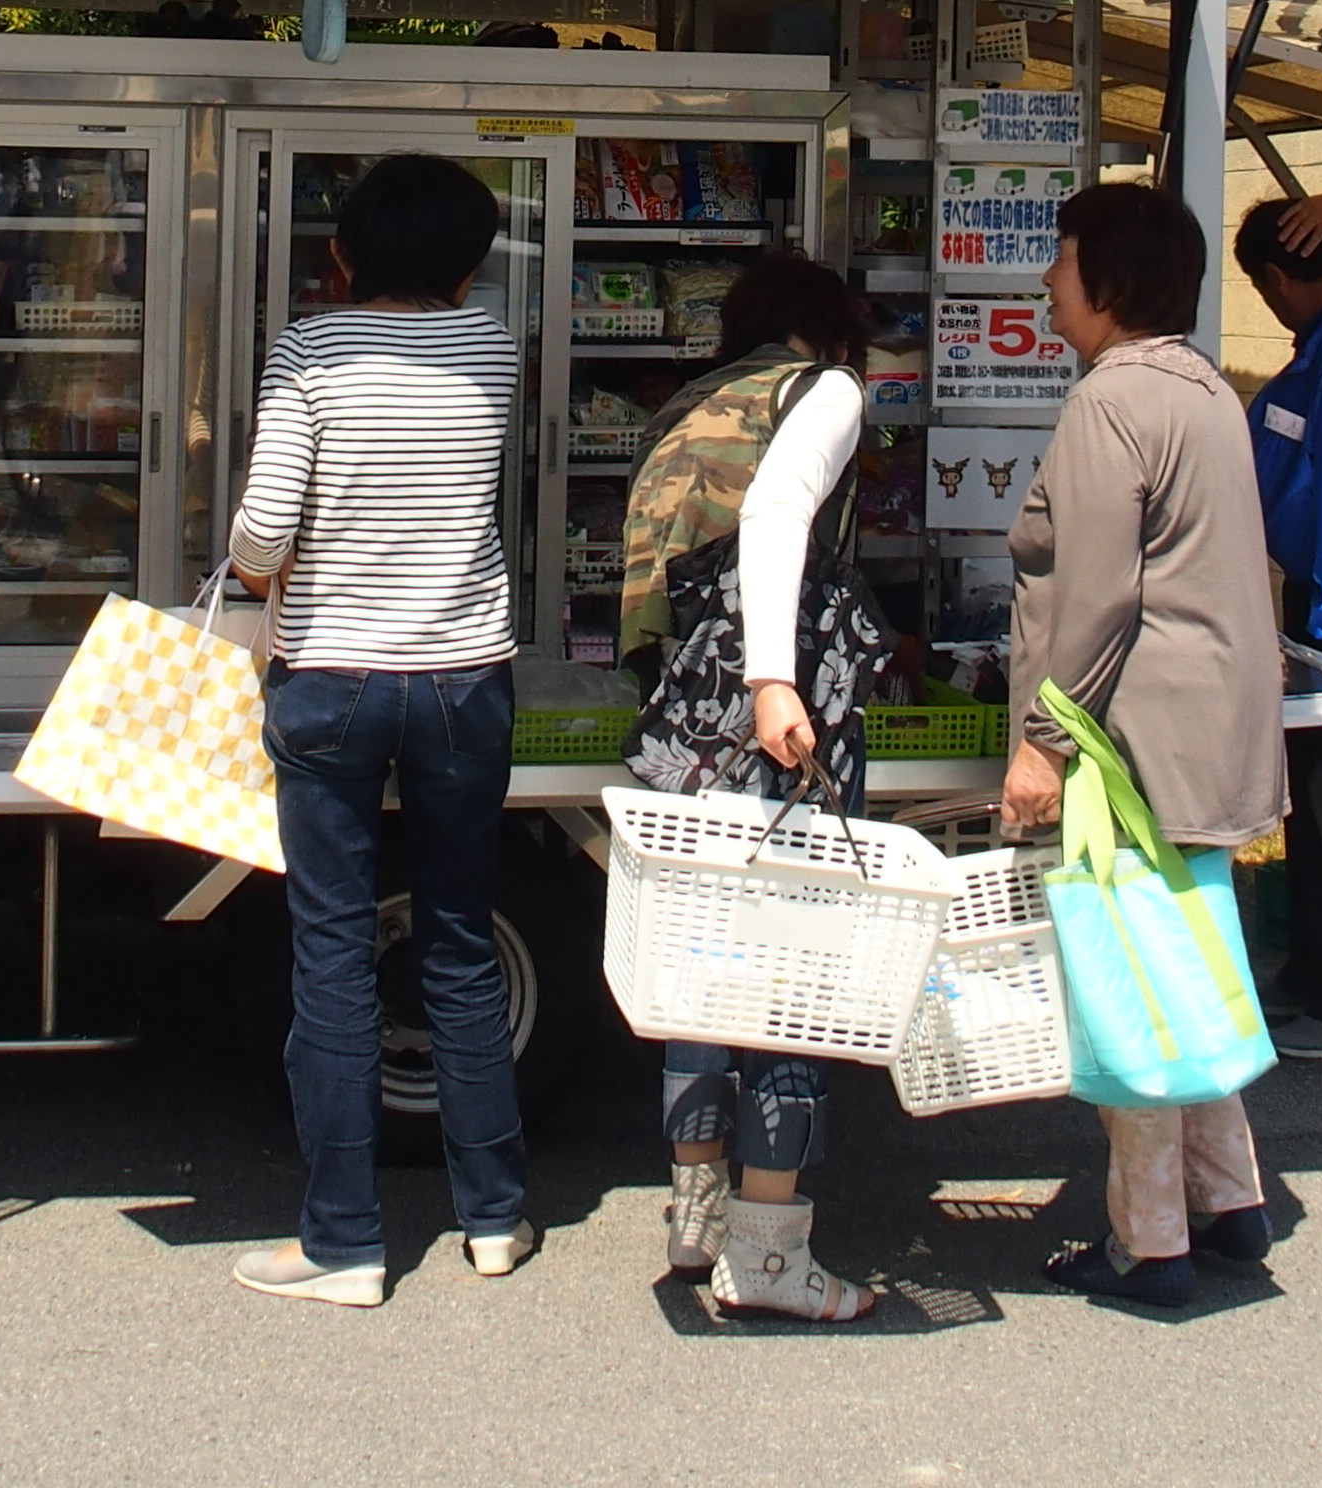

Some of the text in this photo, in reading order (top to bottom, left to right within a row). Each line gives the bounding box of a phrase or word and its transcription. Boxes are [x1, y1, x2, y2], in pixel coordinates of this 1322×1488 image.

[938, 318, 981, 329] お忘れの方
[938, 332, 981, 344] レジ袋
[988, 309, 1064, 357] 5 円
